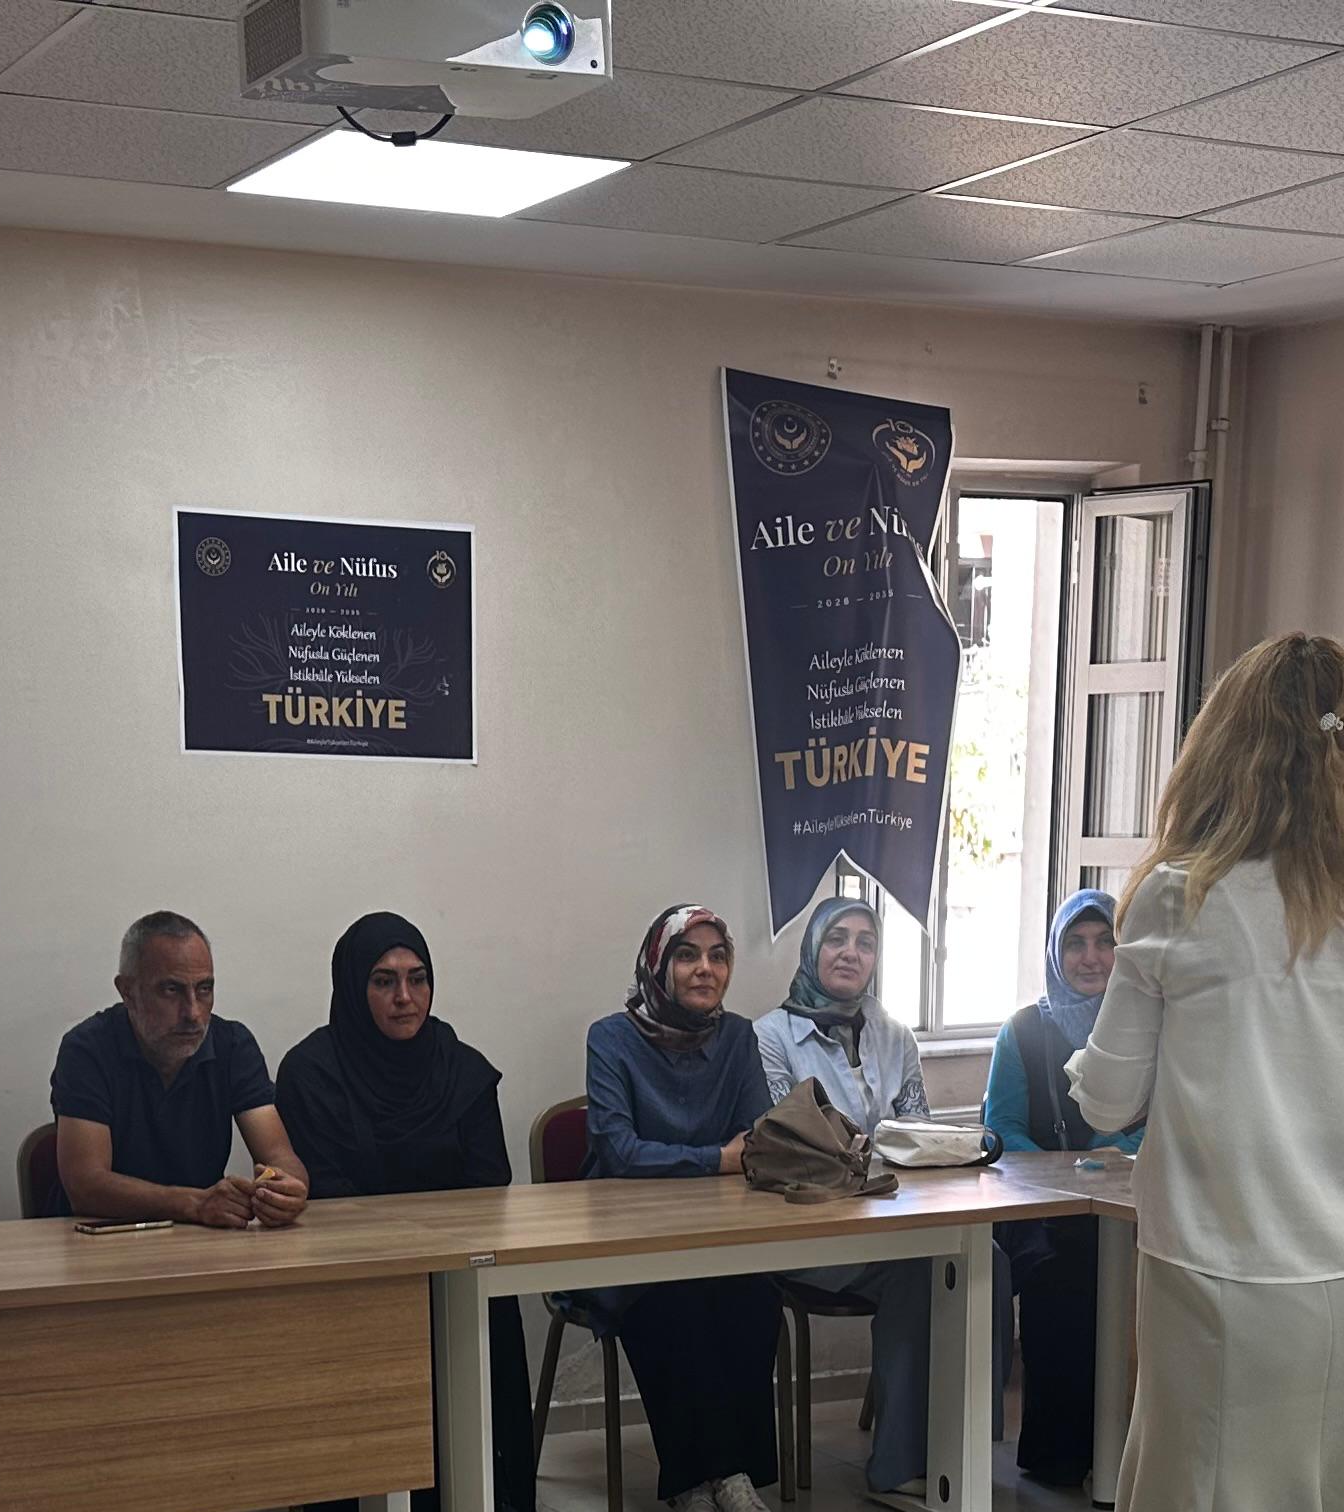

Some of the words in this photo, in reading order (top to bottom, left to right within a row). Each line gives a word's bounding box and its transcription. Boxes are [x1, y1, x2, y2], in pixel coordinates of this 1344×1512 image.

[750, 515, 815, 550] Aile
[826, 516, 861, 541] ve
[268, 552, 308, 573] Aile
[313, 559, 335, 575] ve
[340, 557, 398, 579] Nüfus
[823, 556, 855, 577] On
[310, 581, 330, 596] On
[291, 622, 326, 641] Aileyle
[809, 648, 853, 674] Aileyle
[806, 678, 853, 705] Nüfusla
[262, 686, 406, 729] TÜRKİYE
[773, 726, 930, 790] TÜRKİYE
